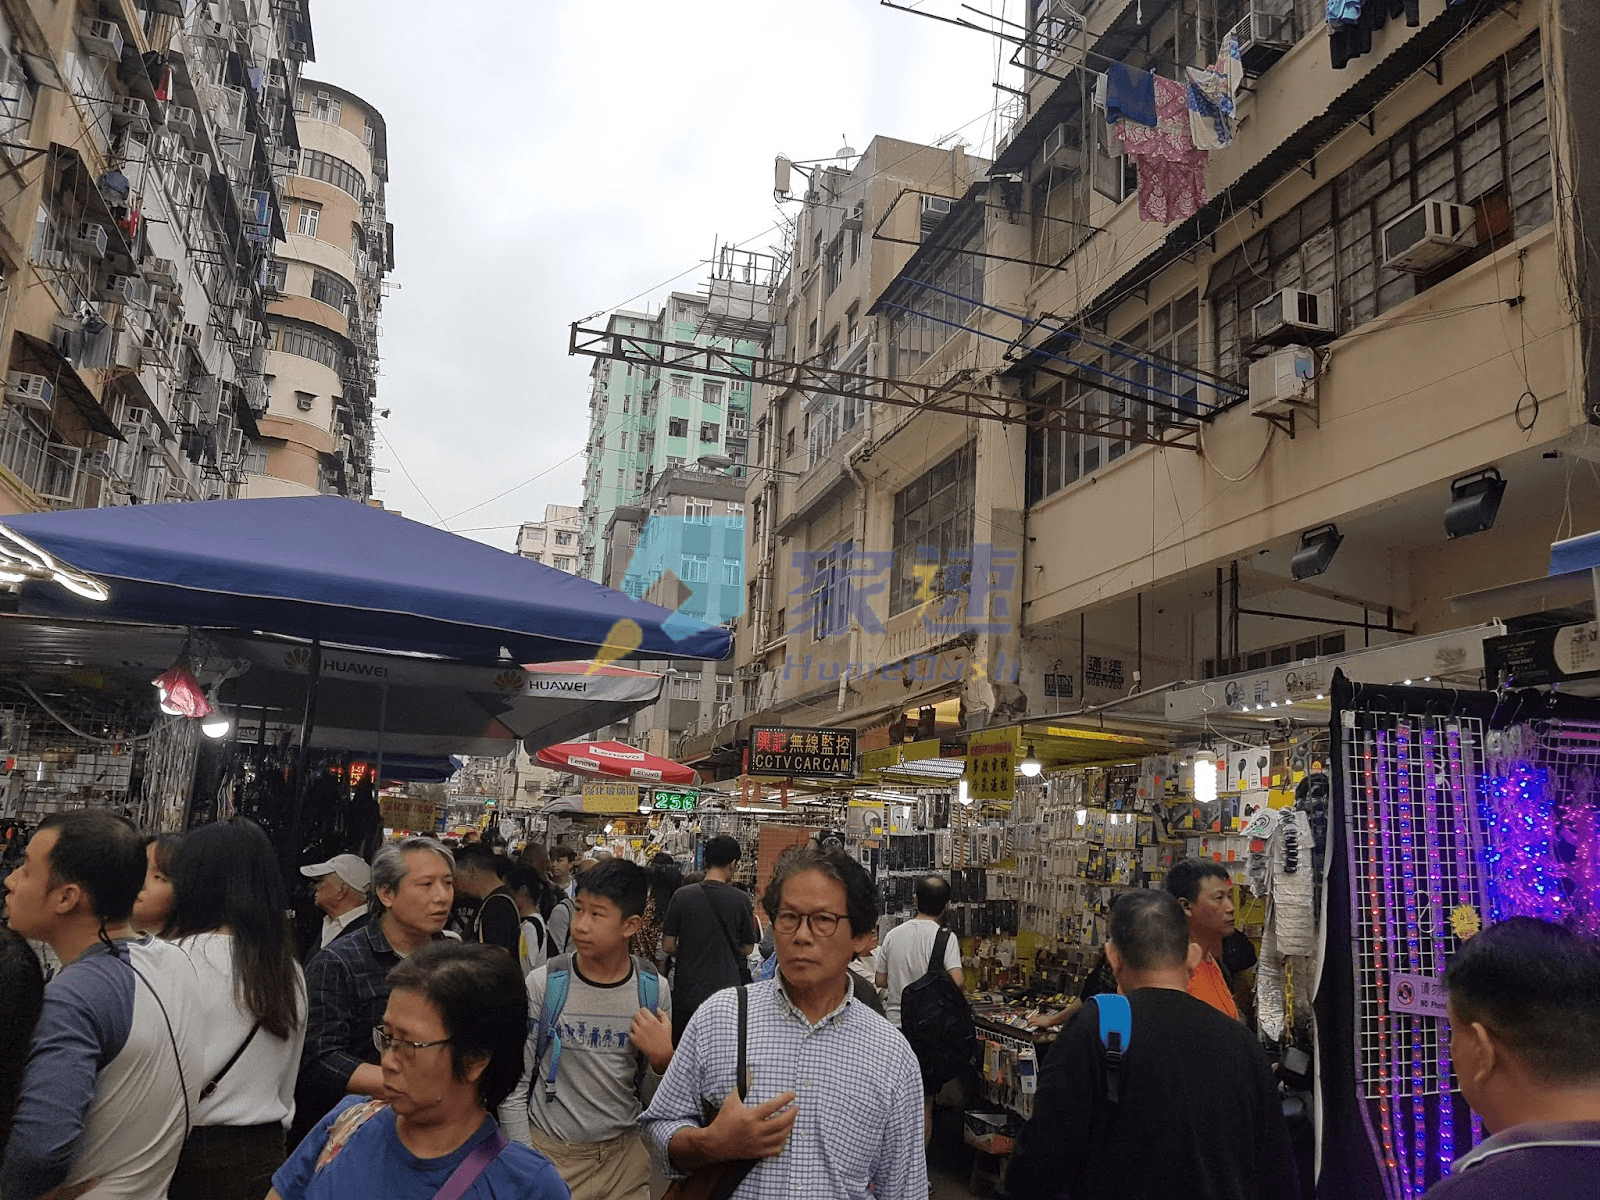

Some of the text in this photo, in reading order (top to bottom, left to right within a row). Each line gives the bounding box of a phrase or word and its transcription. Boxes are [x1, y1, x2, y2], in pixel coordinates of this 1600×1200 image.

[323, 659, 389, 678] HUAWEI
[529, 680, 587, 692] HUAWEI
[594, 748, 640, 760] Lenovo
[570, 757, 597, 768] Lenovo
[633, 769, 659, 778] Lenovo
[655, 791, 695, 813] 256
[1420, 999, 1428, 1008] NO
